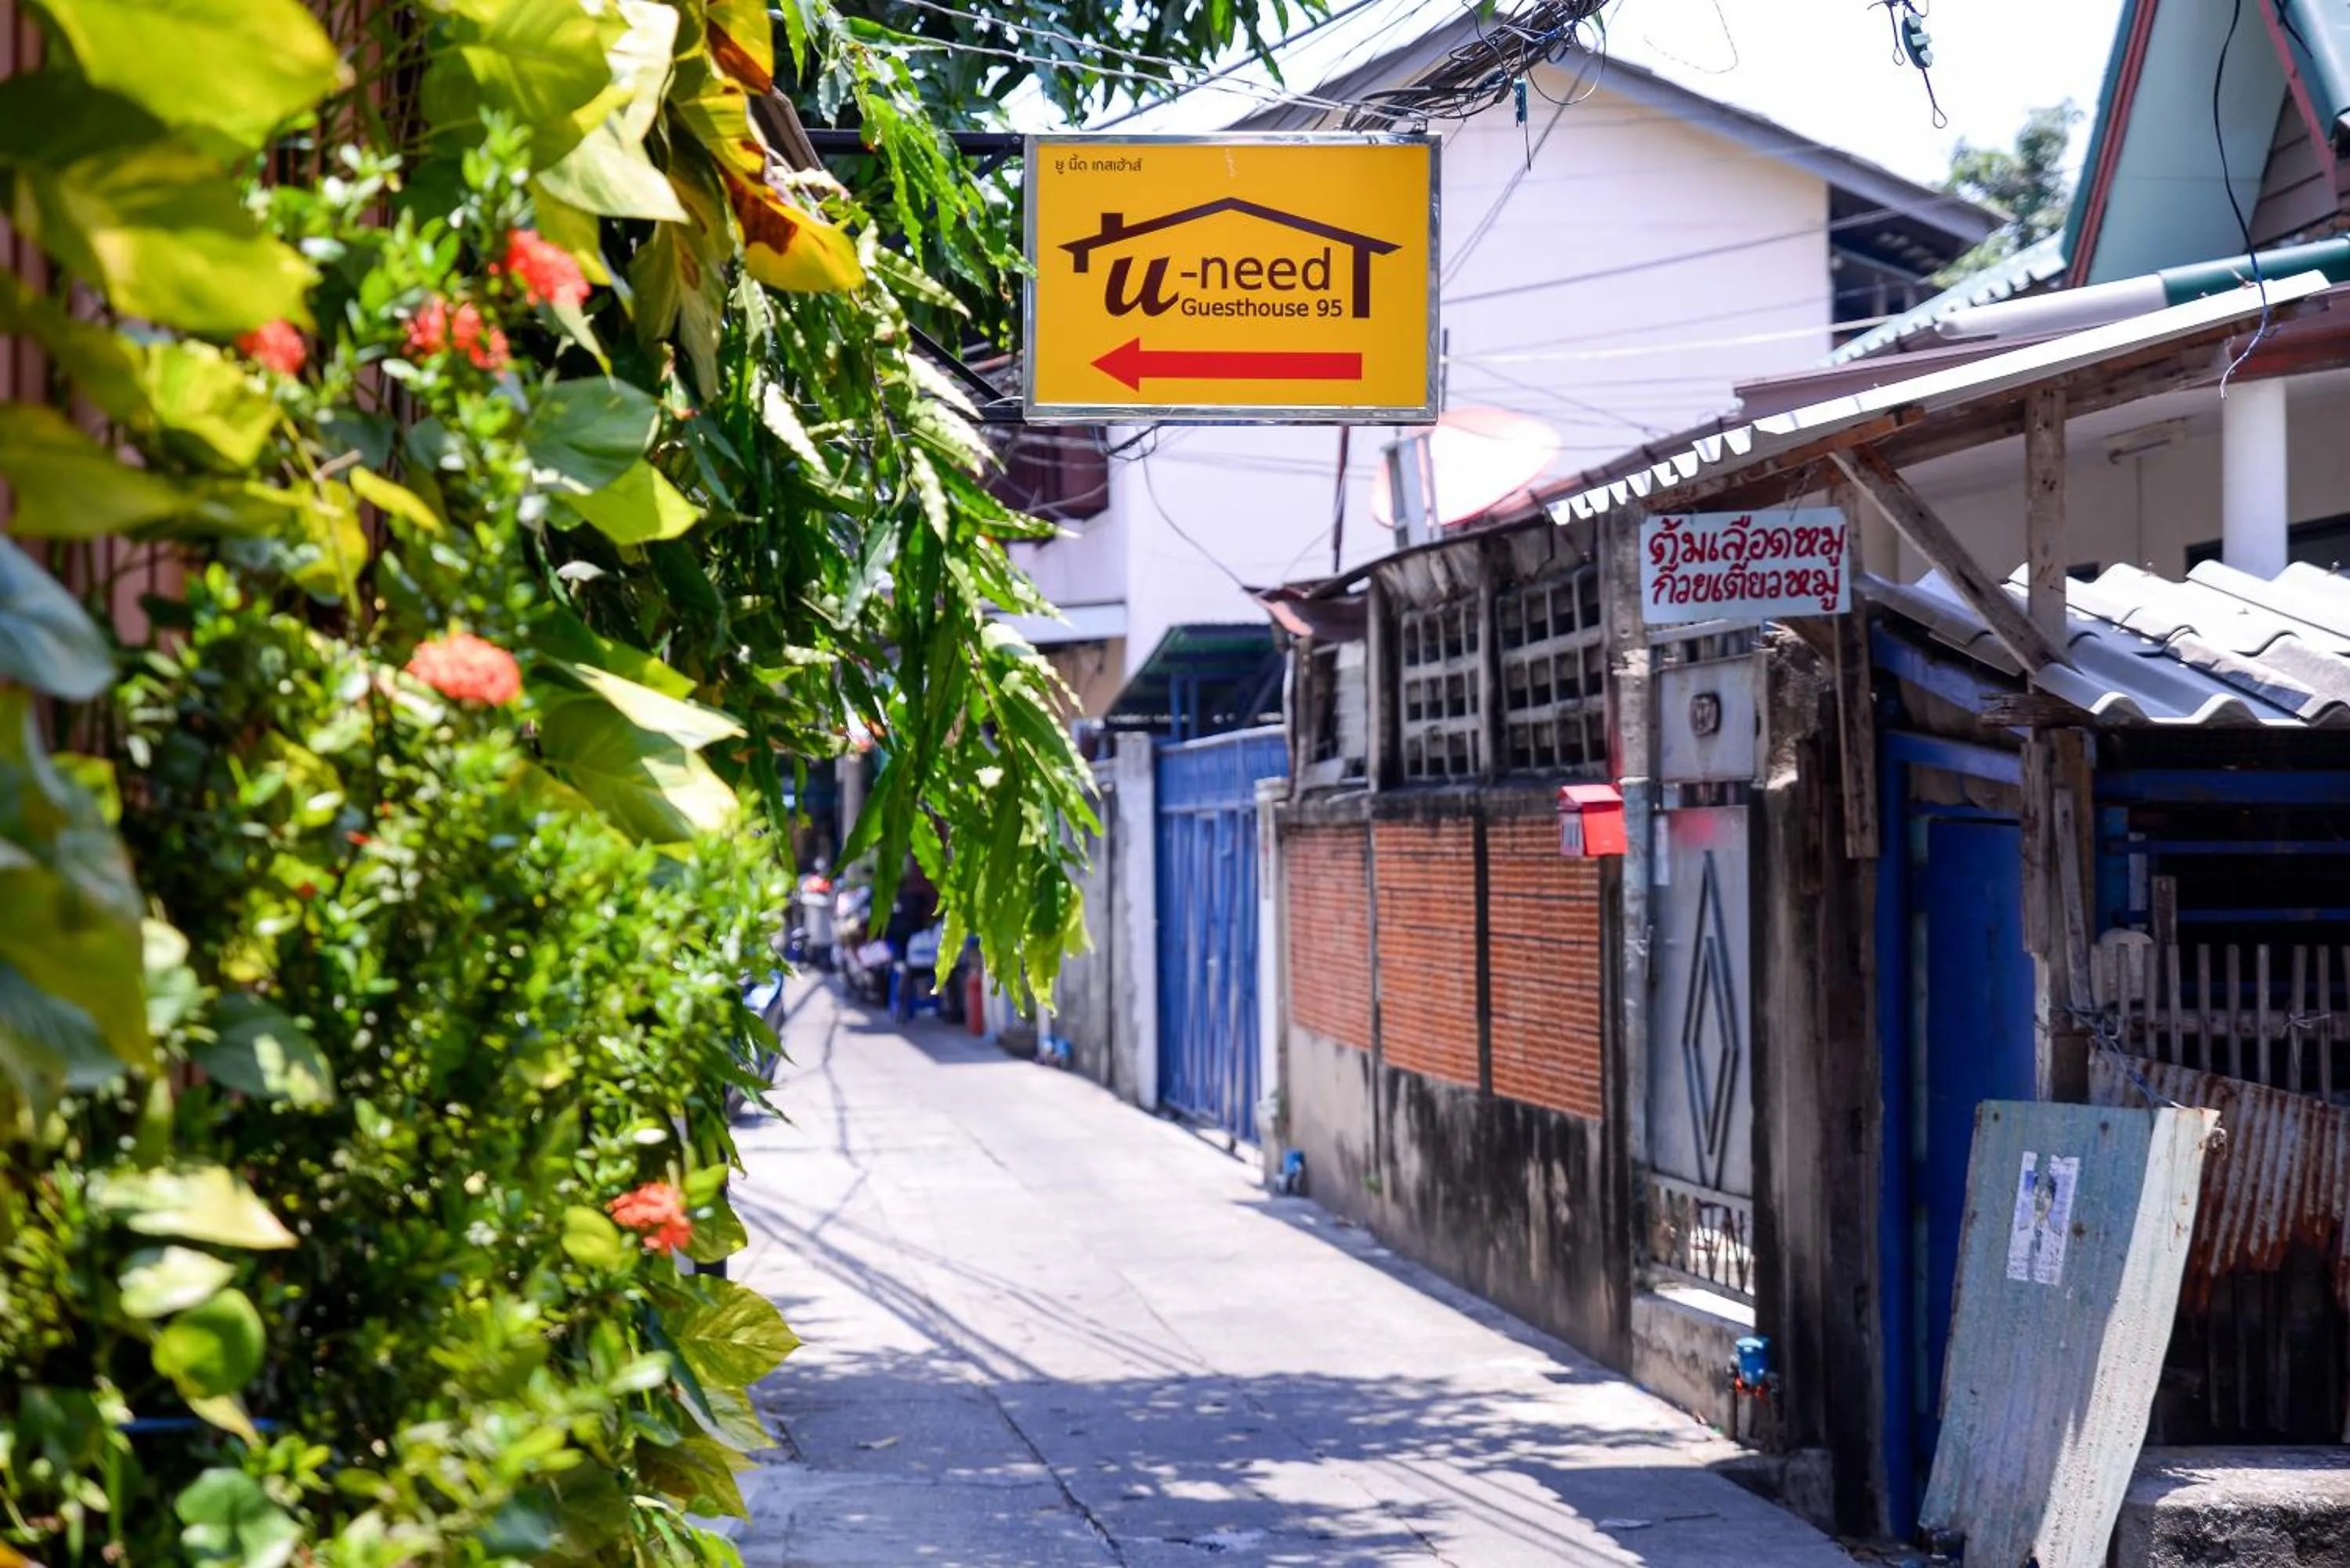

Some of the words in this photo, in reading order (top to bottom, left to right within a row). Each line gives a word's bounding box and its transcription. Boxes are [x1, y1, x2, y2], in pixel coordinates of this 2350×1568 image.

[1055, 160, 1065, 174] ยู
[1180, 298, 1308, 317] Guesthouse
[1316, 298, 1342, 317] 95
[1648, 515, 1845, 567] ต้มเลือดหมู
